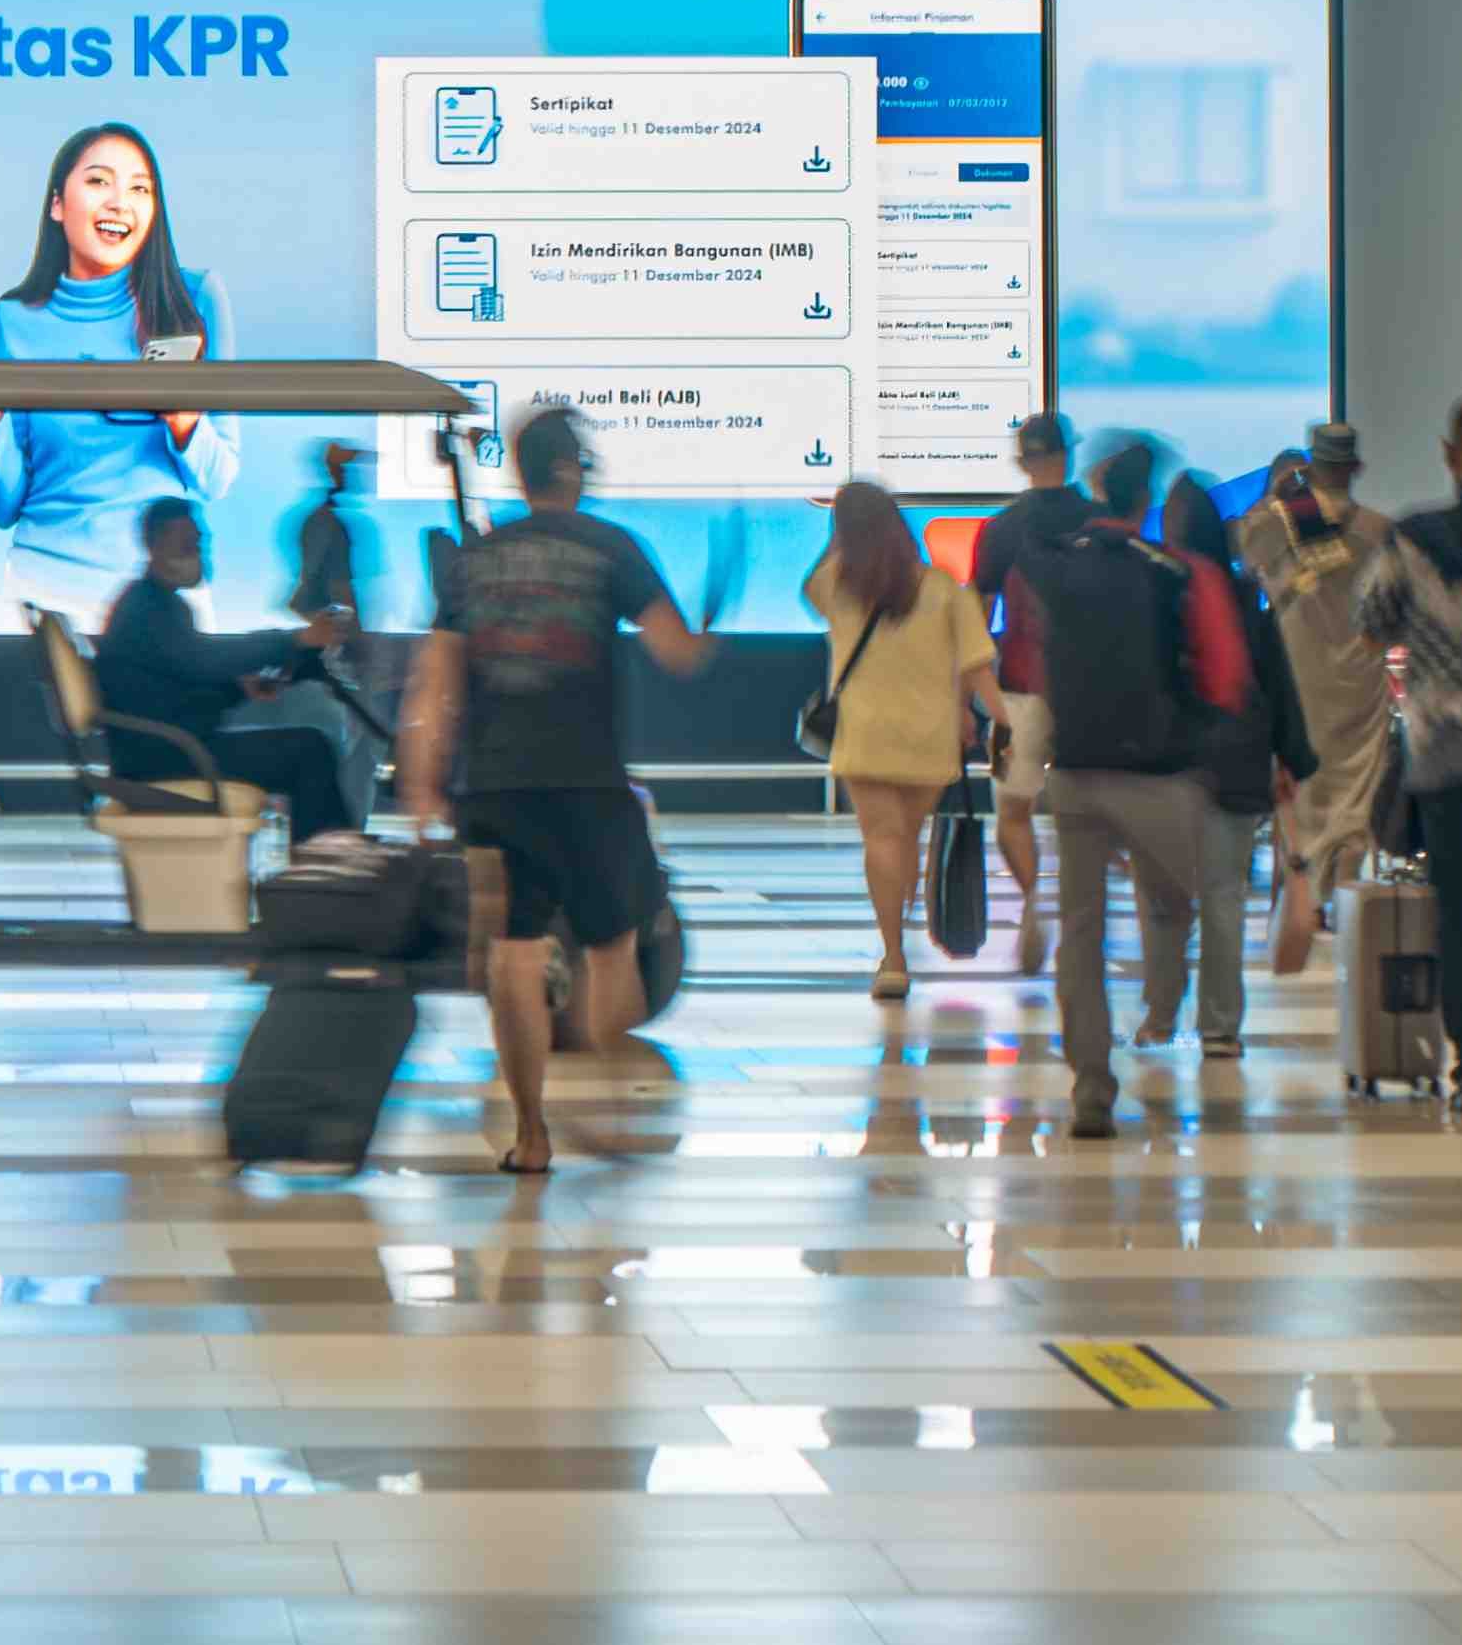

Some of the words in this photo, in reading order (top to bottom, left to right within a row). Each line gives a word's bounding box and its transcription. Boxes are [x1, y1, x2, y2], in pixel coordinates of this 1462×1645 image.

[132, 15, 290, 77] KPR
[530, 96, 613, 113] Sertipikat
[530, 122, 564, 135] Valid
[569, 122, 616, 137] hingga
[623, 123, 638, 135] 11
[645, 122, 719, 136] Desember
[724, 123, 762, 135] 2024
[531, 244, 562, 258] Izin
[568, 243, 668, 258] Mendirikan
[675, 244, 762, 262] Bangunan
[769, 243, 814, 260] (IMB)
[531, 269, 564, 281] Valid
[569, 269, 617, 283] hingga
[623, 269, 638, 281] 11
[645, 269, 720, 281] Desember
[725, 269, 762, 281] 2024
[531, 391, 571, 405] Akta
[577, 390, 613, 405] Jual
[619, 390, 651, 404] Beli
[657, 390, 701, 407] (AJB)
[623, 417, 639, 429] 11
[646, 417, 720, 429] Desember
[726, 417, 763, 429] 2024
